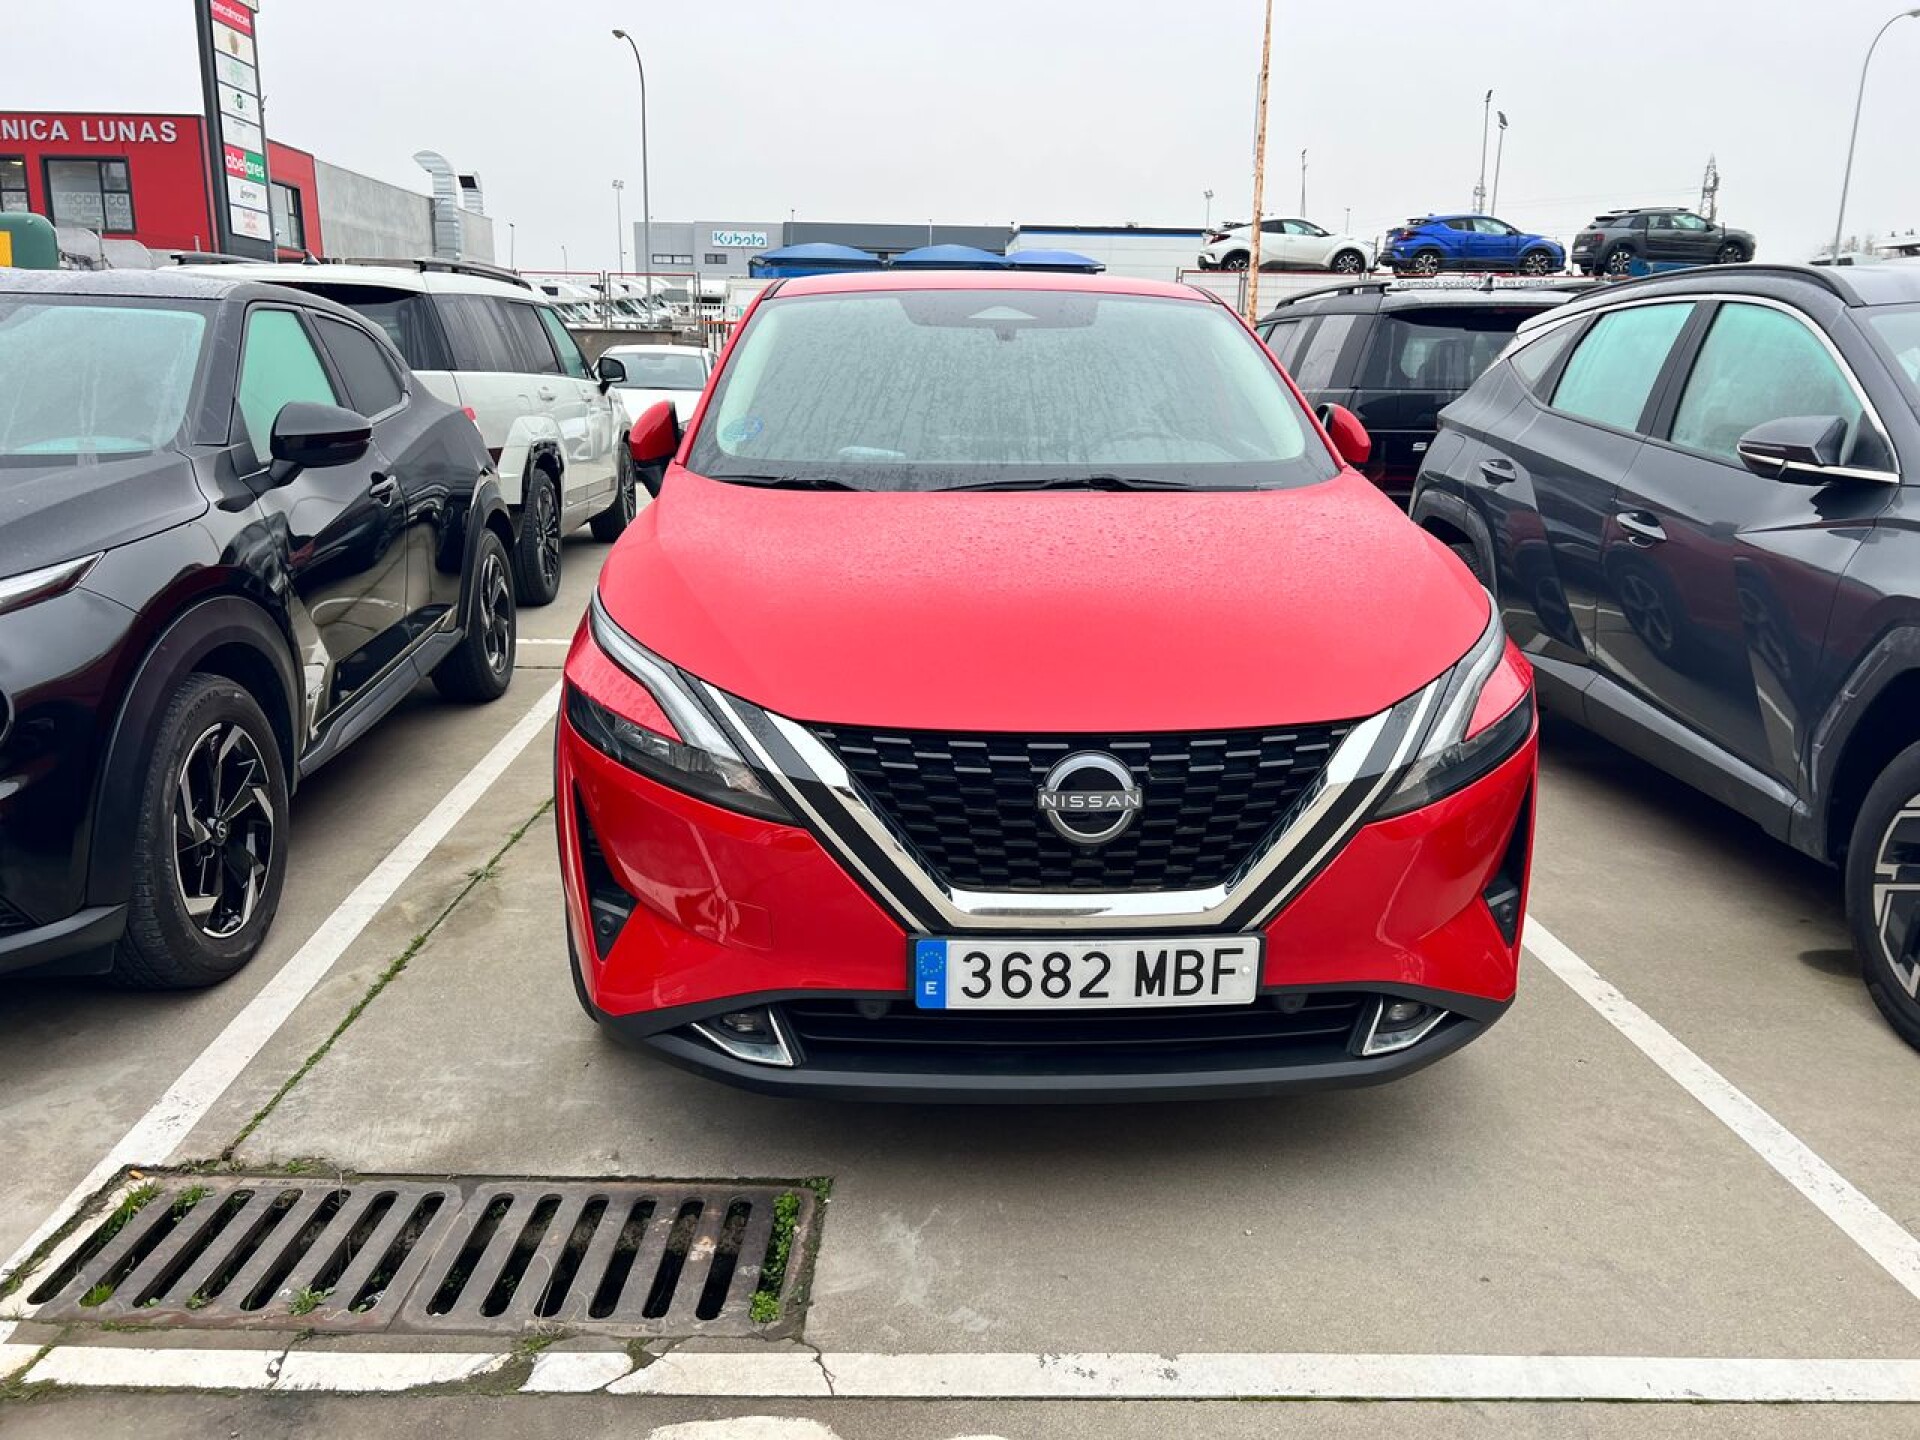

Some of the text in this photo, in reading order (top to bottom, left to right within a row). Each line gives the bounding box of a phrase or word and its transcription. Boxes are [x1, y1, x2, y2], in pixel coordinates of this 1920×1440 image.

[0, 119, 178, 143] NICA LUNAS
[714, 232, 766, 245] Kubota
[1398, 278, 1439, 289] Gamboa
[1041, 794, 1140, 808] NISSAN
[961, 947, 1244, 1000] 3682 MBF
[925, 981, 937, 995] E
